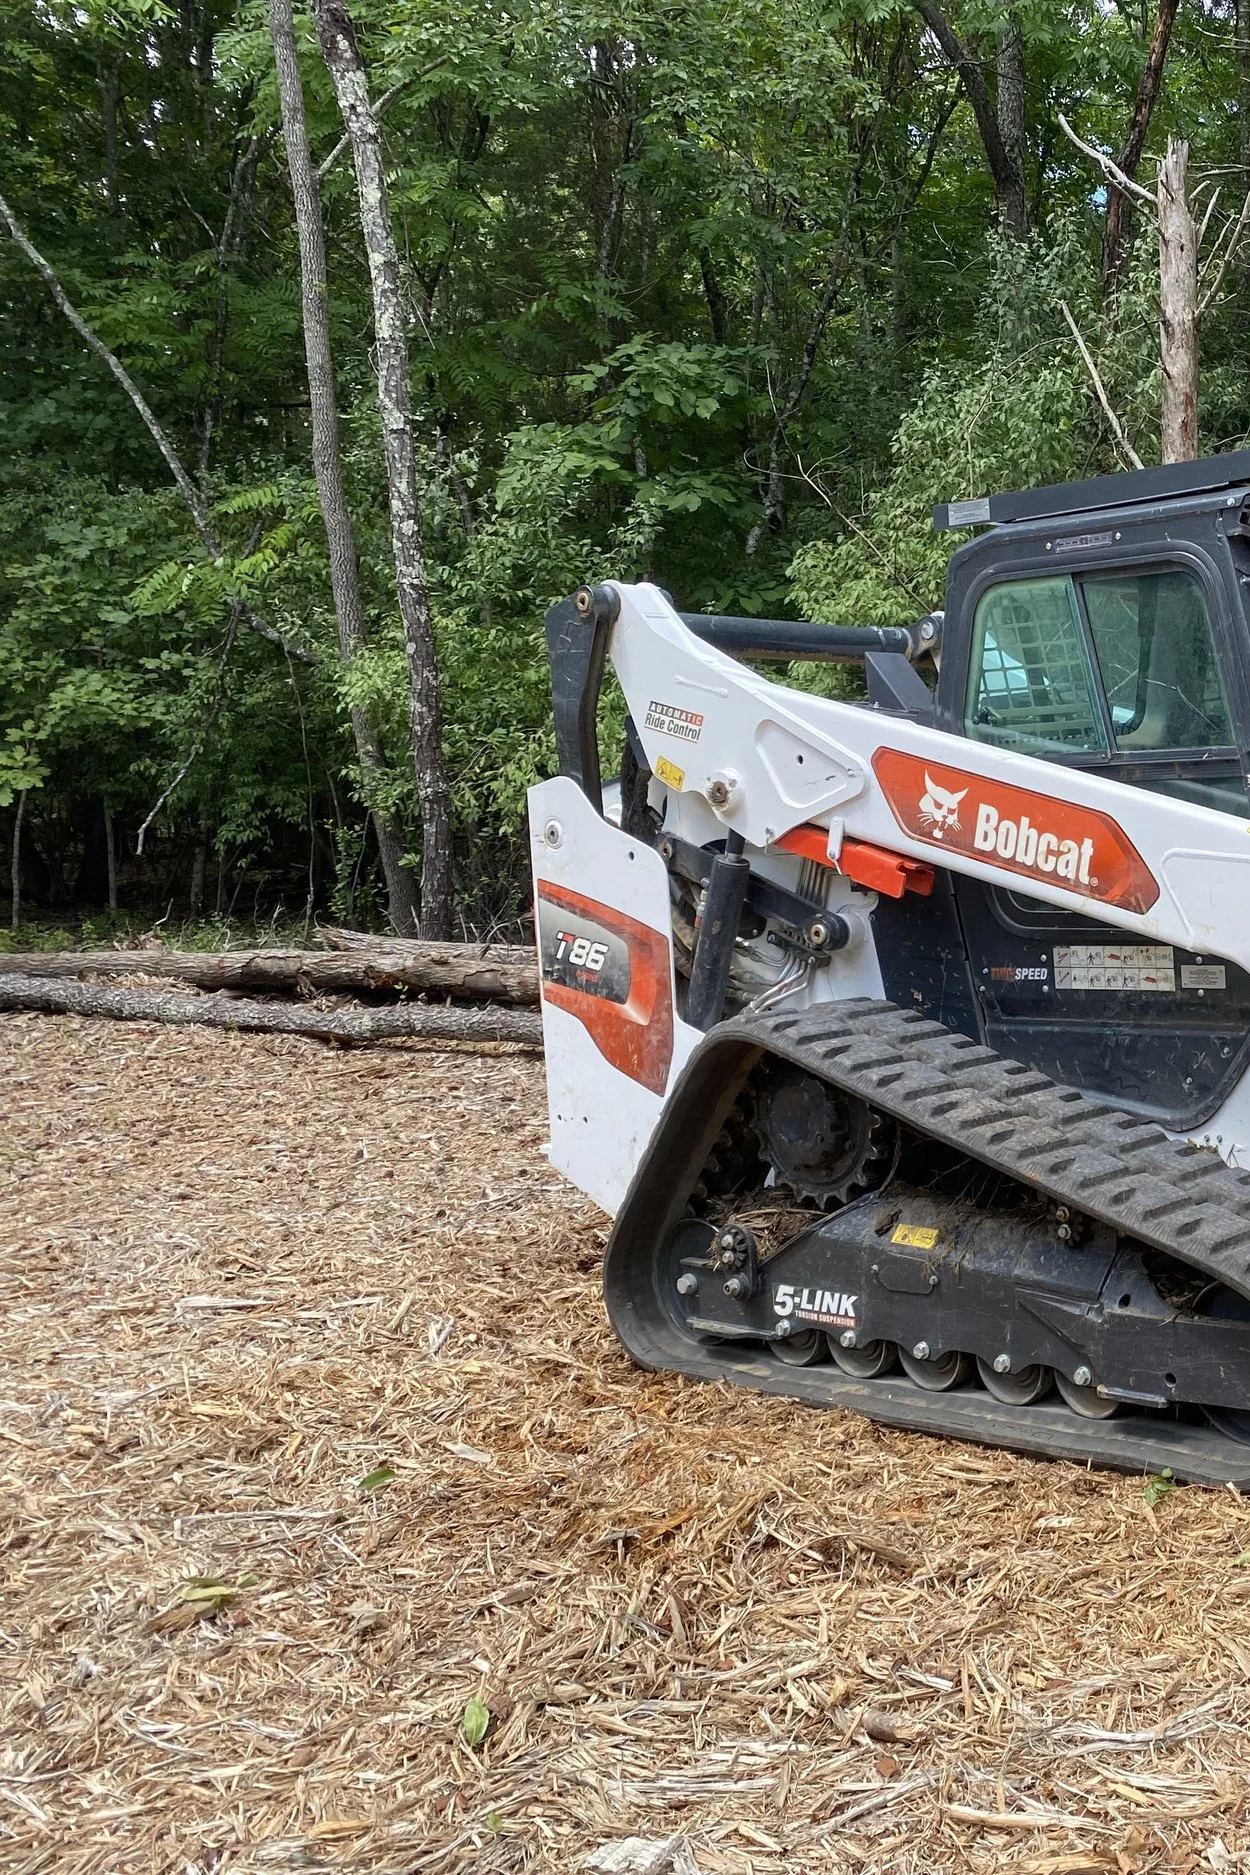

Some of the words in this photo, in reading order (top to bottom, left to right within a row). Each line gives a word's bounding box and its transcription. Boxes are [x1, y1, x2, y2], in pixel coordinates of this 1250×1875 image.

[645, 713, 665, 730] Ride
[667, 720, 701, 741] Control
[650, 703, 702, 725] AUTOMATIC
[974, 803, 1093, 884] Bobcat
[556, 931, 609, 971] T86
[773, 1284, 858, 1317] 5-LINK
[795, 1310, 818, 1321] TORSION
[819, 1313, 855, 1327] SUSPENSION
